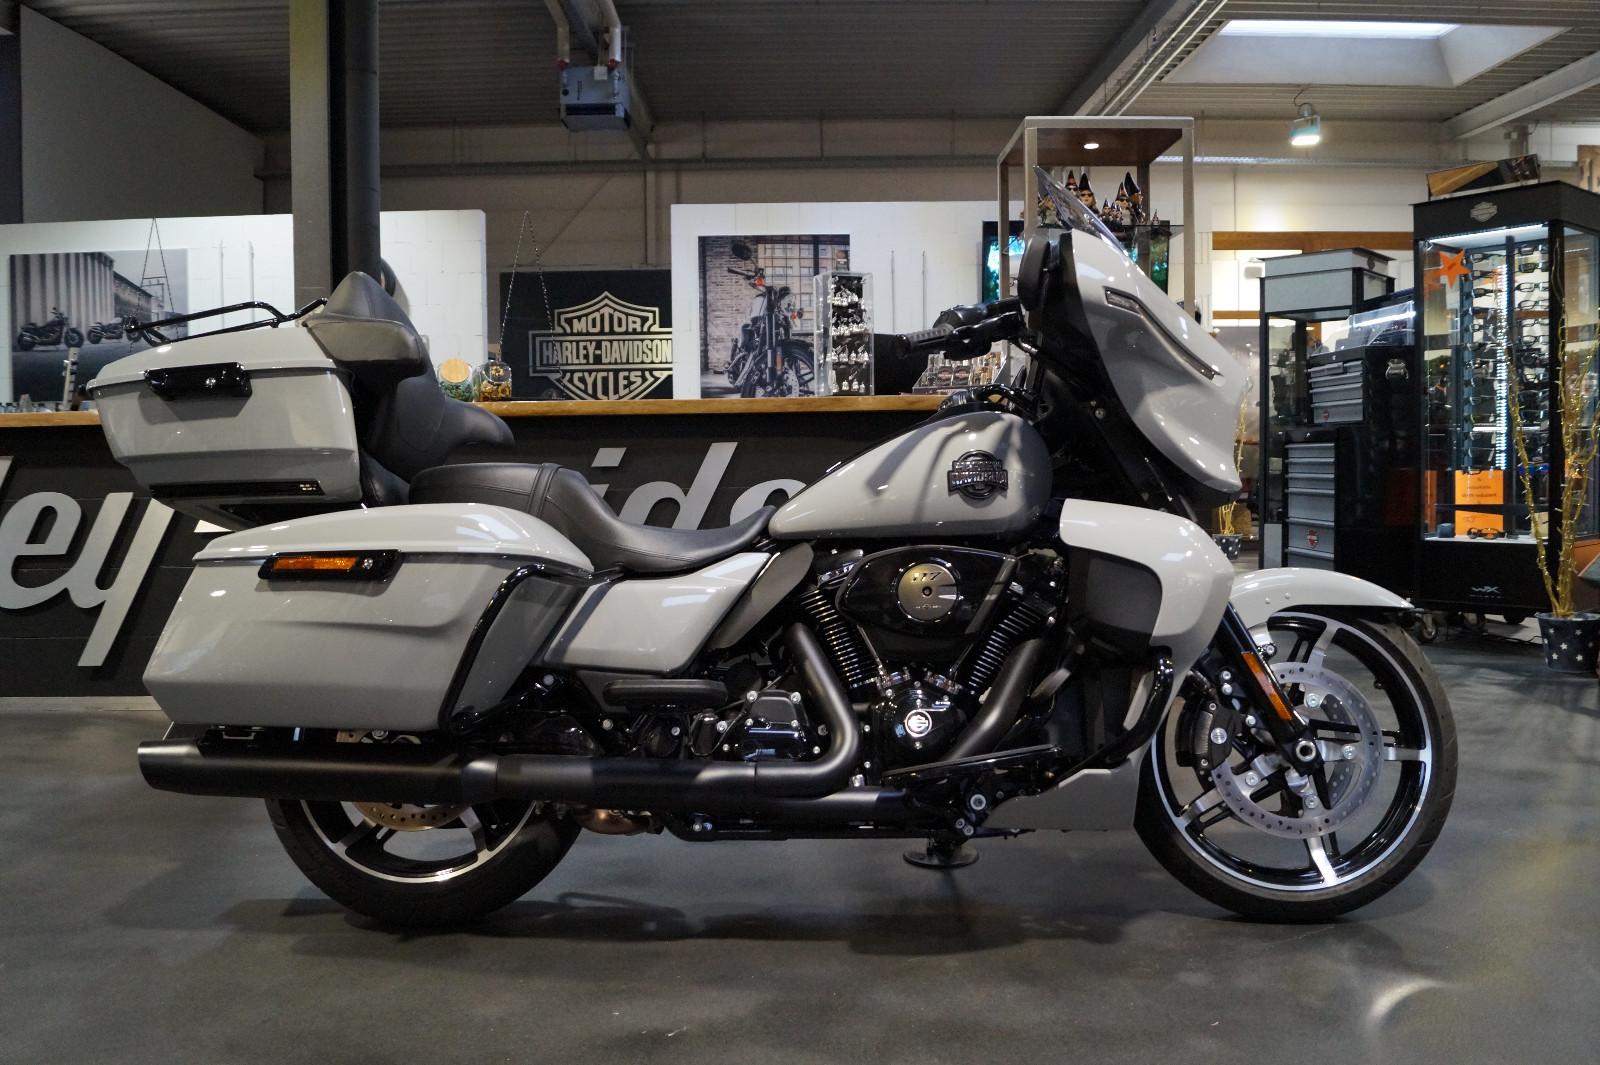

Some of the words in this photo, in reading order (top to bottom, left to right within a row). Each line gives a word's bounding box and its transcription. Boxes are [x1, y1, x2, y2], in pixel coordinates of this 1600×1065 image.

[572, 305, 642, 333] MOTOR
[542, 340, 673, 365] HARLEY-DAVIDSON
[572, 371, 643, 400] CYCLES
[0, 456, 175, 667] ey
